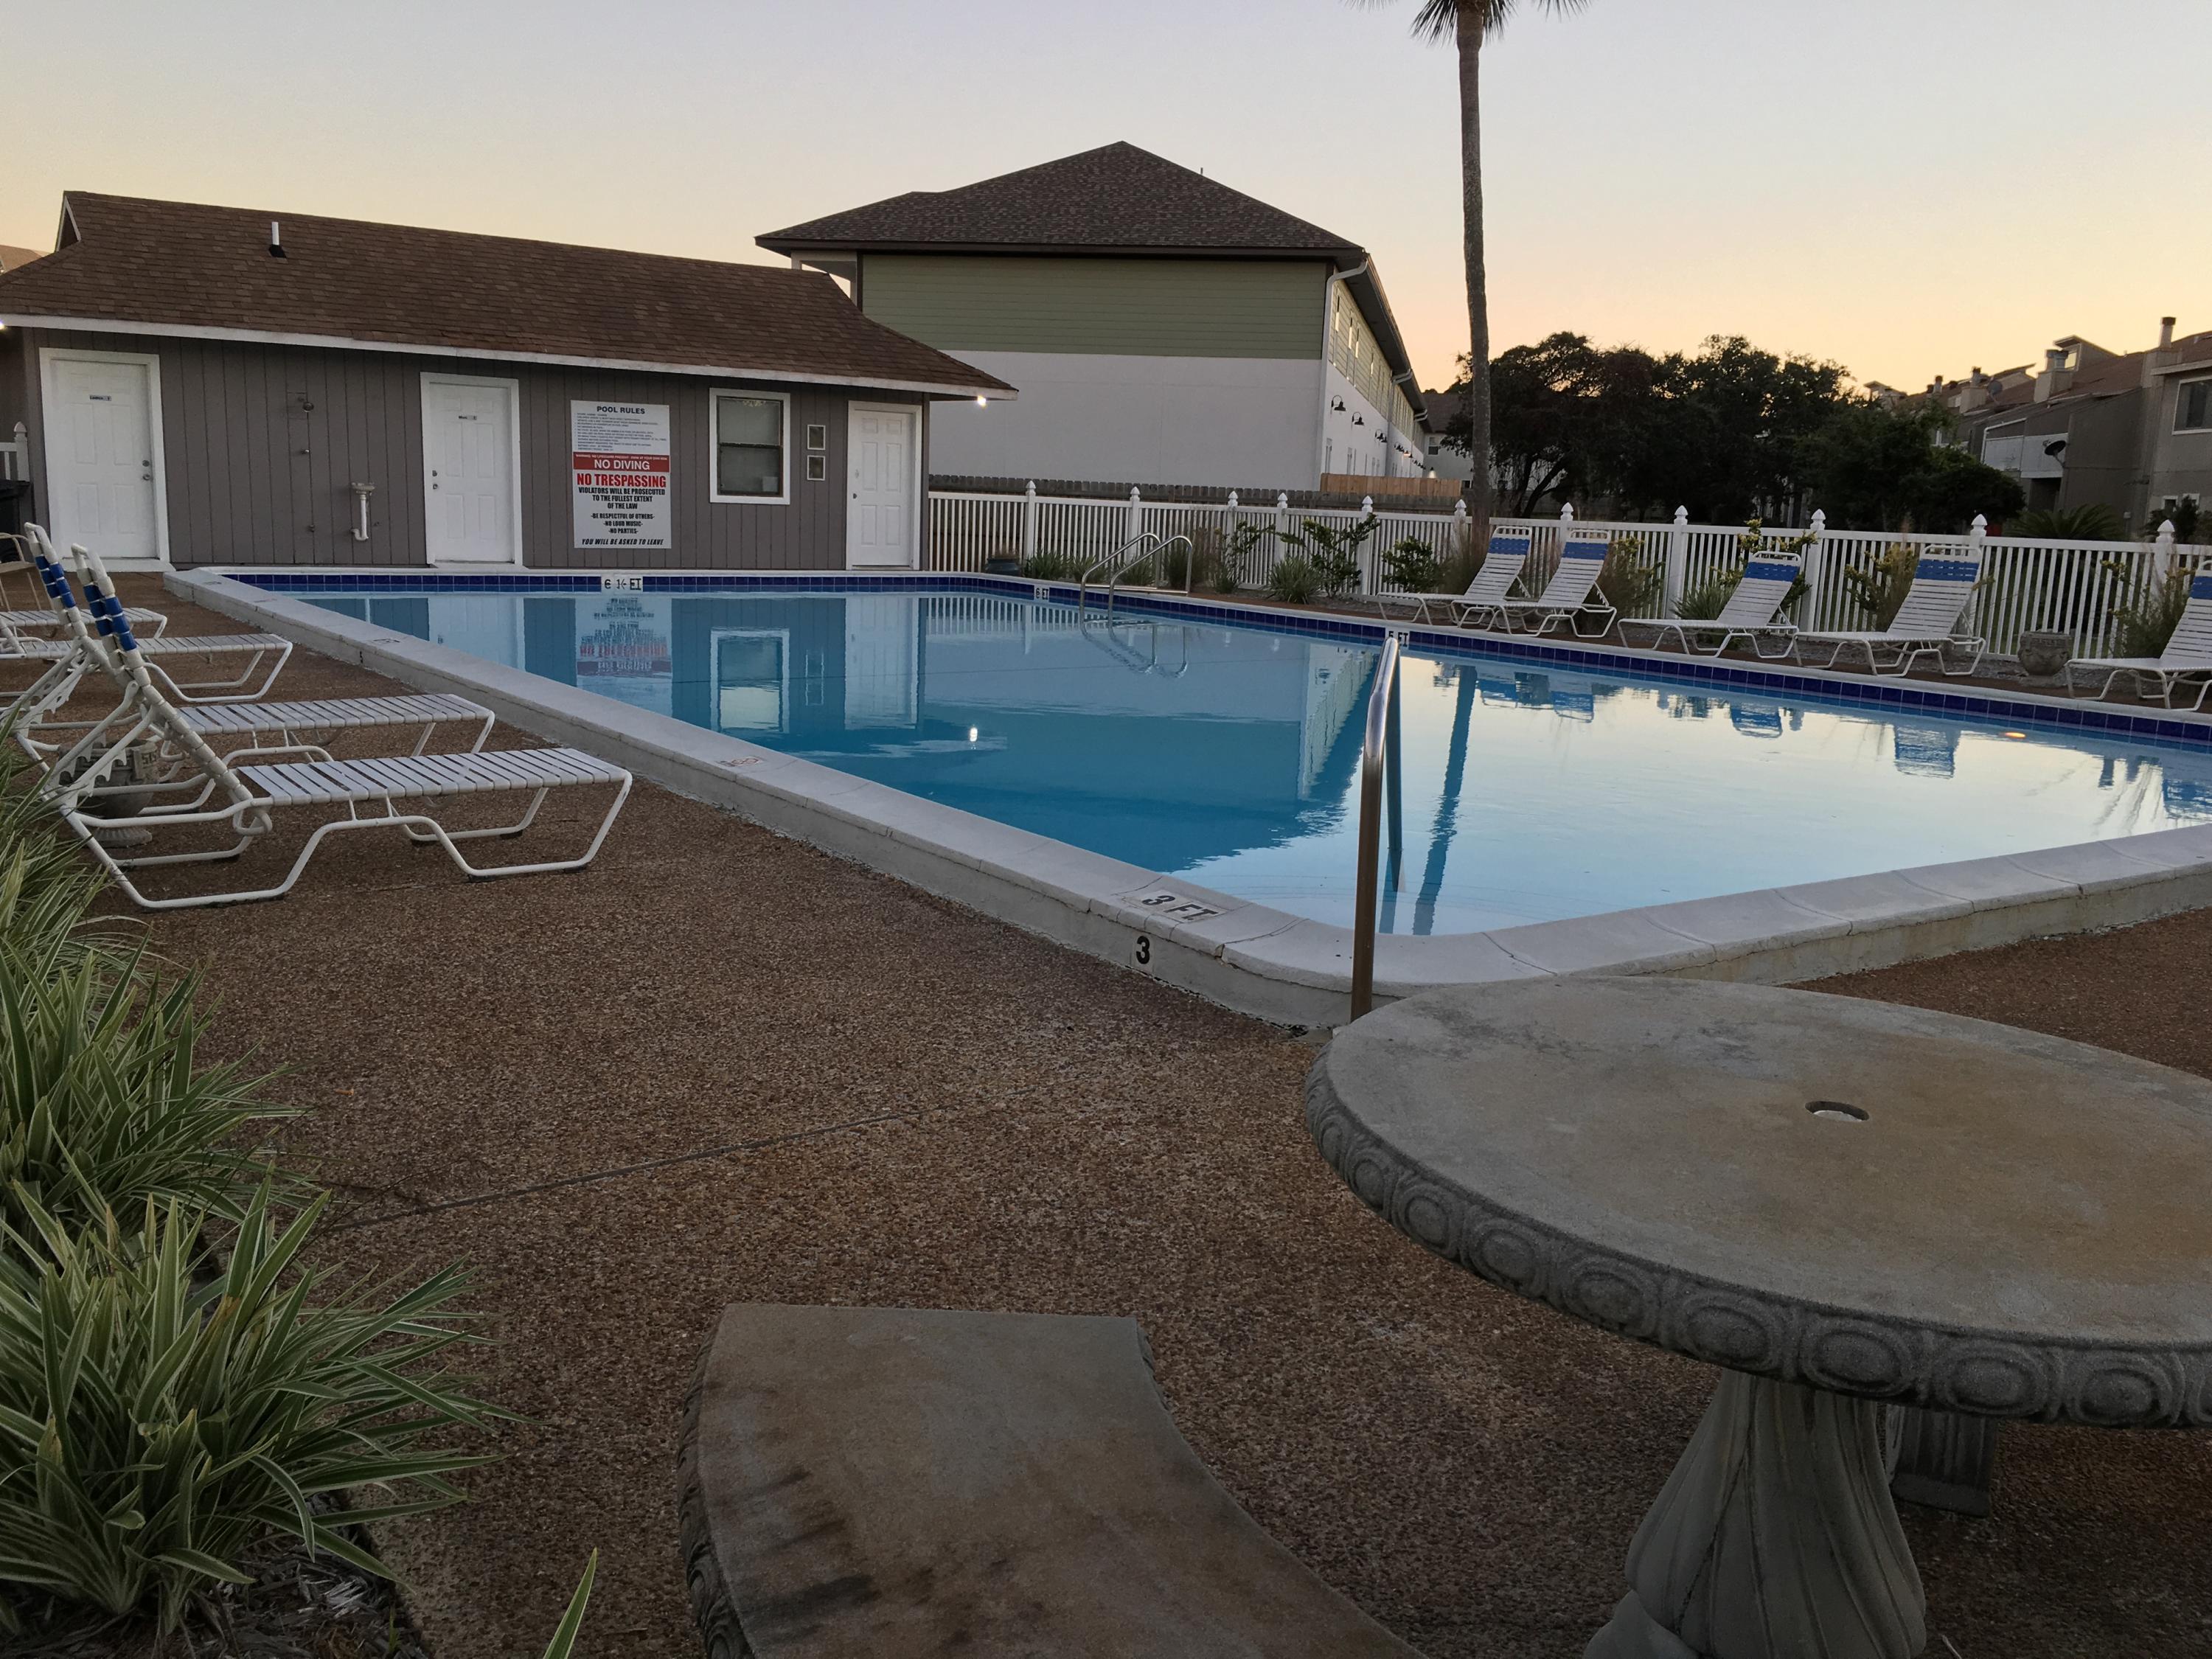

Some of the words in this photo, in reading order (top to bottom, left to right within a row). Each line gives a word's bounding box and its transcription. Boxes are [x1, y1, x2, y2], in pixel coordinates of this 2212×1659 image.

[594, 460, 610, 469] NO
[613, 461, 650, 470] DIVING
[577, 473, 591, 485] NO
[595, 474, 666, 487] TRESPASSING
[1141, 895, 1175, 905] 3
[1136, 936, 1150, 964] 3
